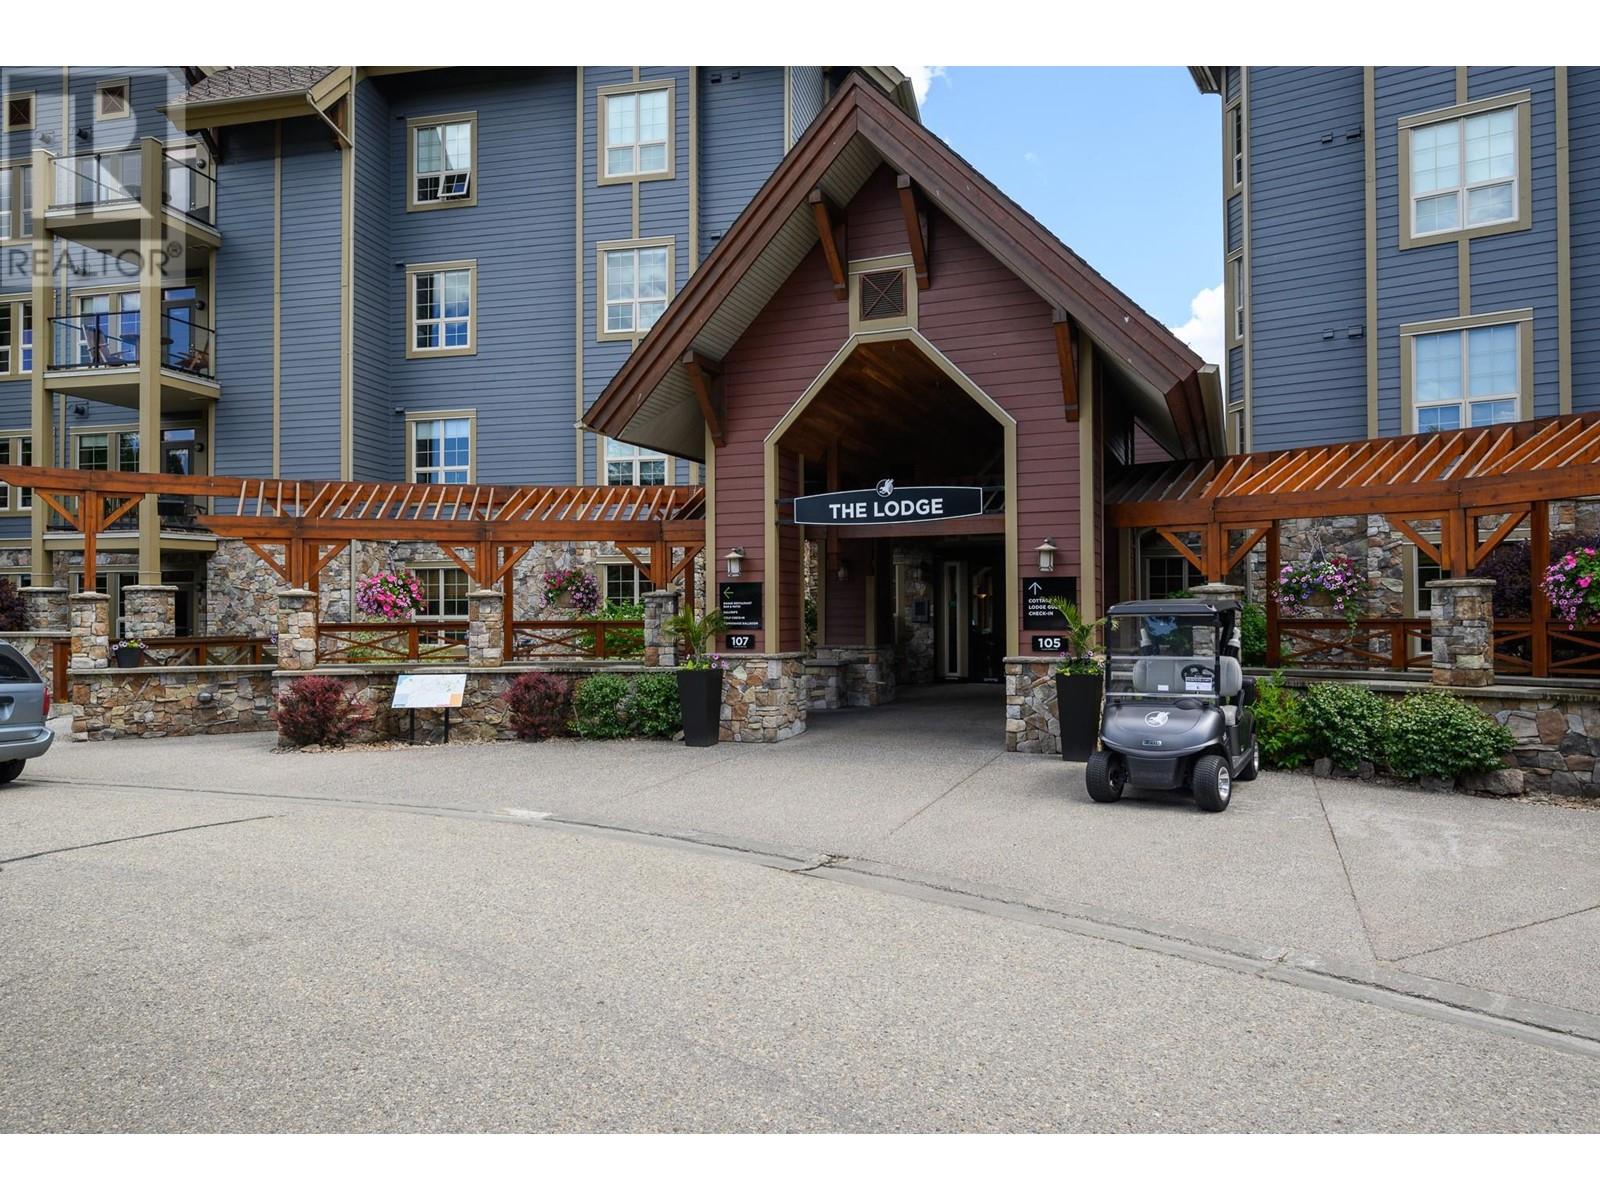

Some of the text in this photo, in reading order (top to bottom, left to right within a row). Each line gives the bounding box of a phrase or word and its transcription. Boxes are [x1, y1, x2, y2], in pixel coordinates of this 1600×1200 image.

[829, 498, 944, 519] THE LODGE
[731, 636, 749, 646] 107
[1038, 637, 1061, 648] 105
